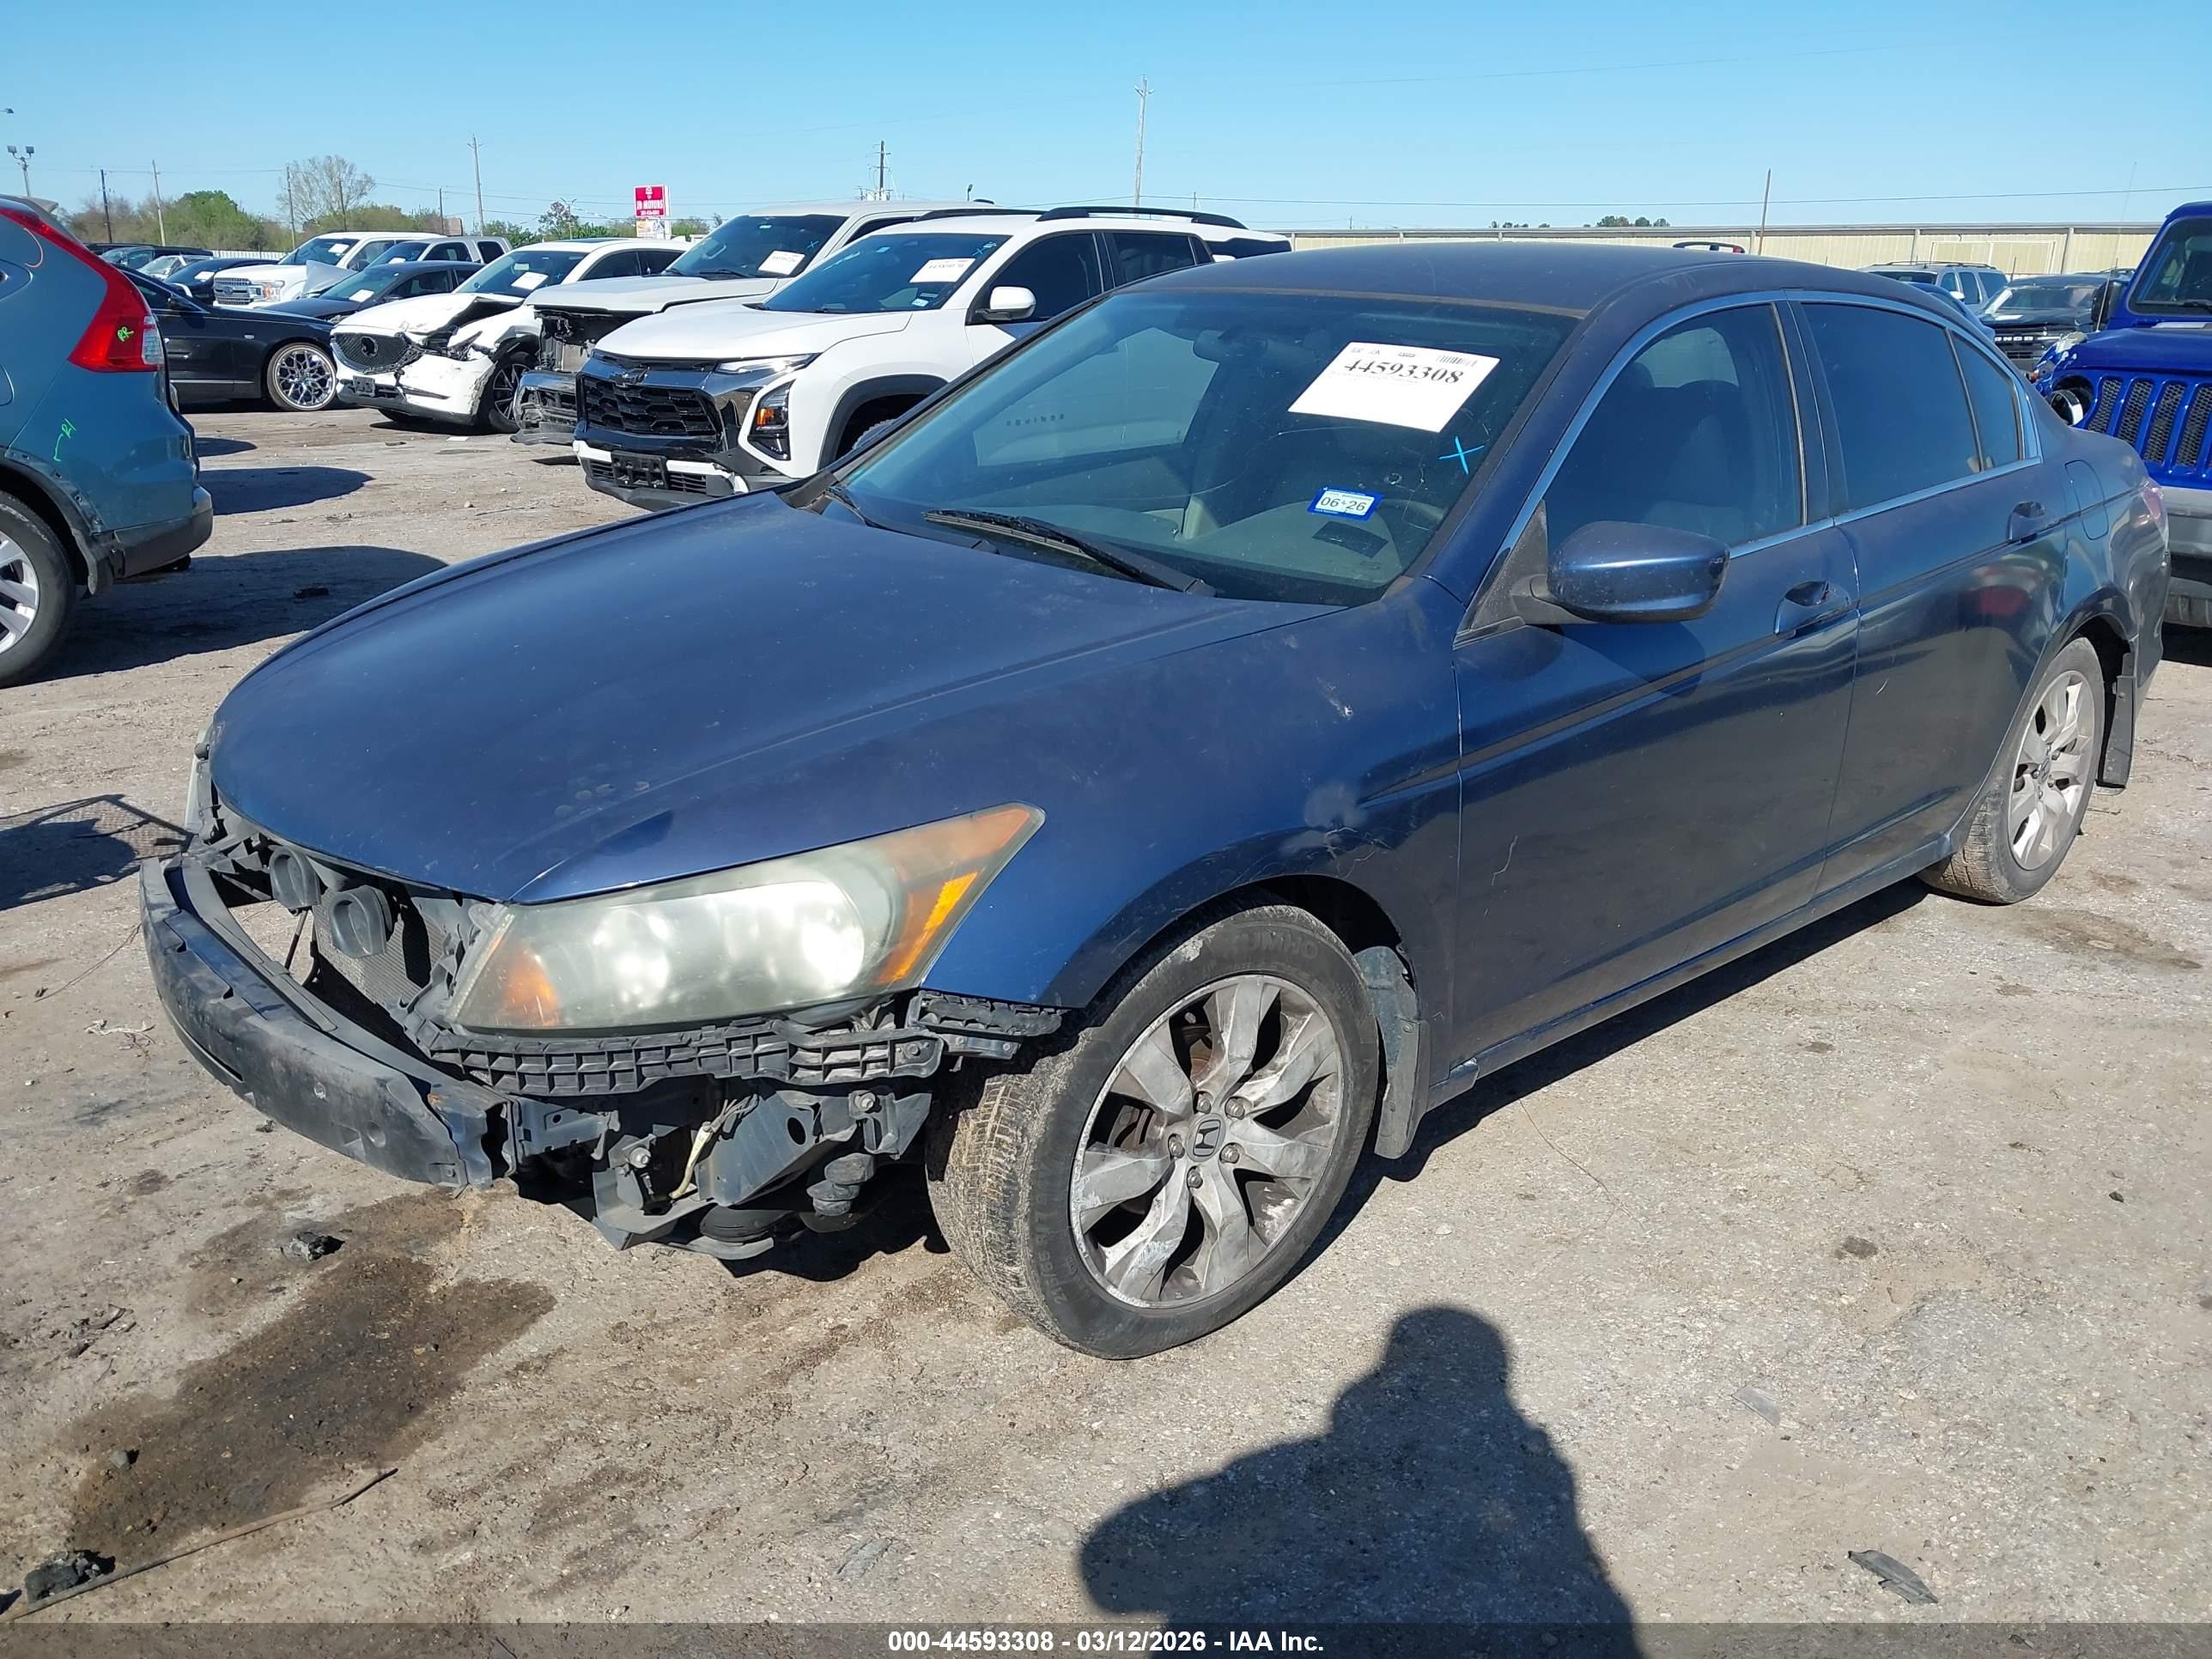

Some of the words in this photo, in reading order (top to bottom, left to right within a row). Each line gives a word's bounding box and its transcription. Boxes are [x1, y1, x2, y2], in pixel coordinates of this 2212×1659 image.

[1344, 359, 1464, 384] 44593308
[1321, 496, 1340, 507] 06
[1346, 500, 1367, 511] 26
